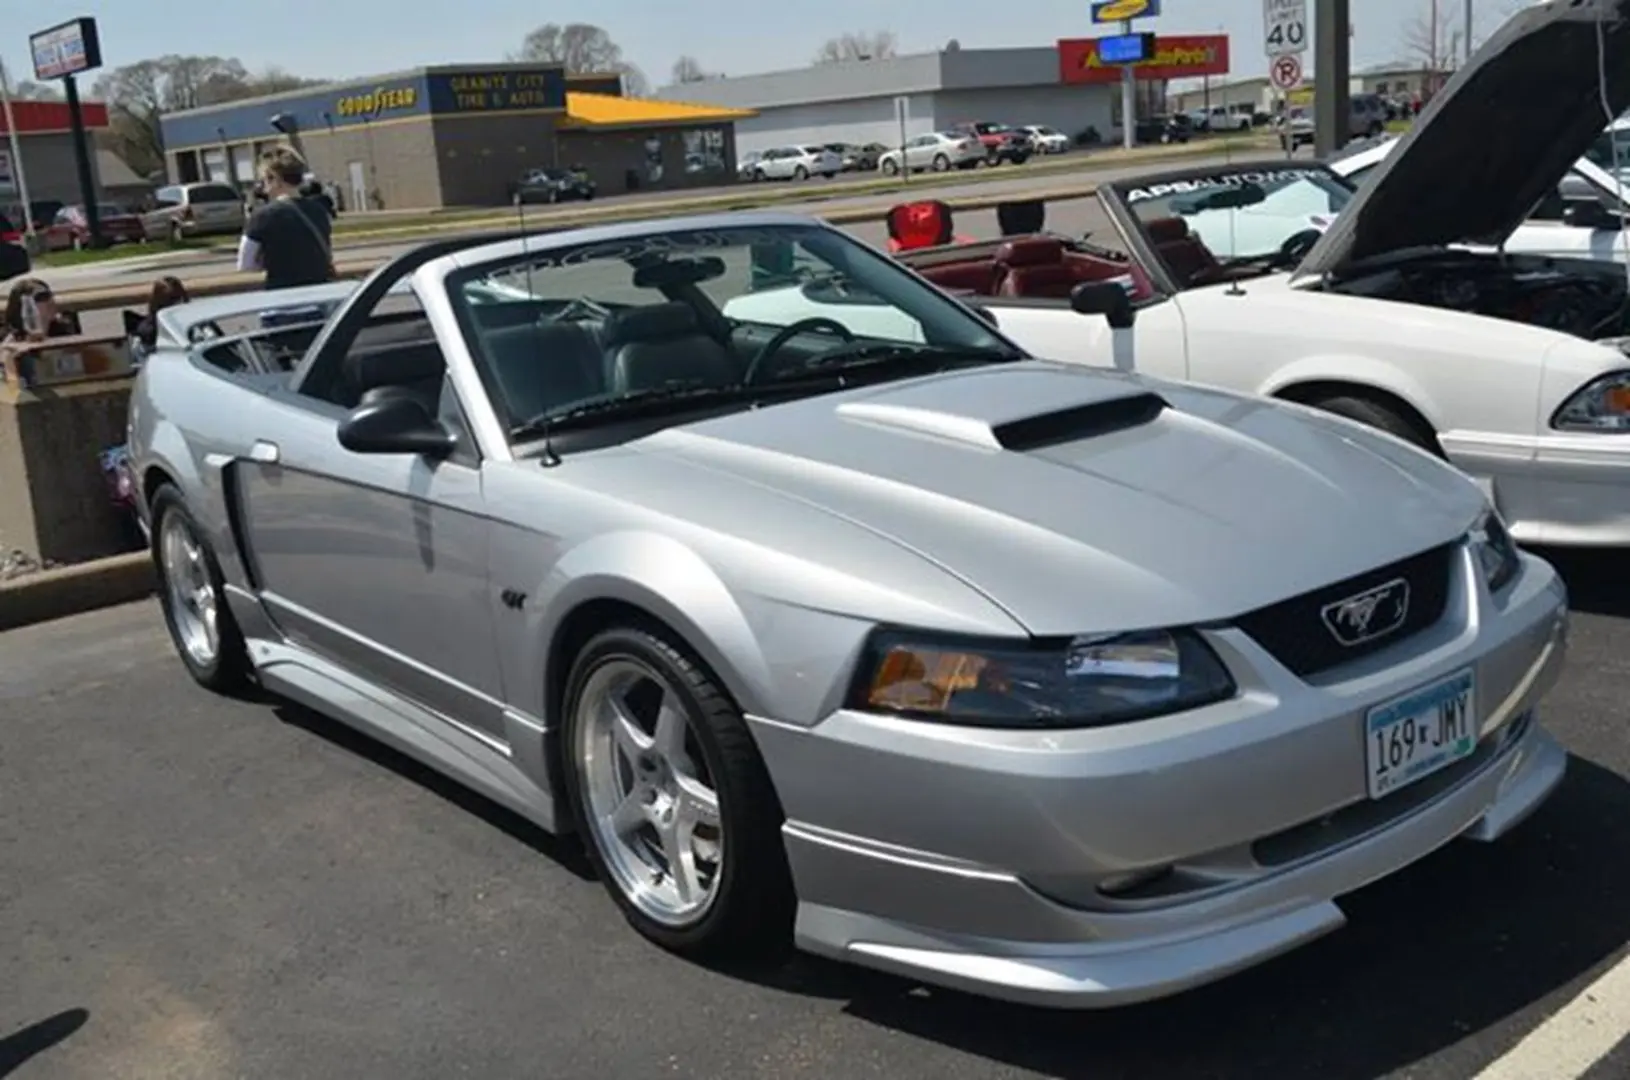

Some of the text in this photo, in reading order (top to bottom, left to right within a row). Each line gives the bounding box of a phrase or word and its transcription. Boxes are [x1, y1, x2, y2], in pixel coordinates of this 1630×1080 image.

[1267, 21, 1304, 45] 40
[337, 86, 417, 117] GOODYEAR
[1376, 718, 1415, 775] 169
[1432, 693, 1468, 748] JMY
